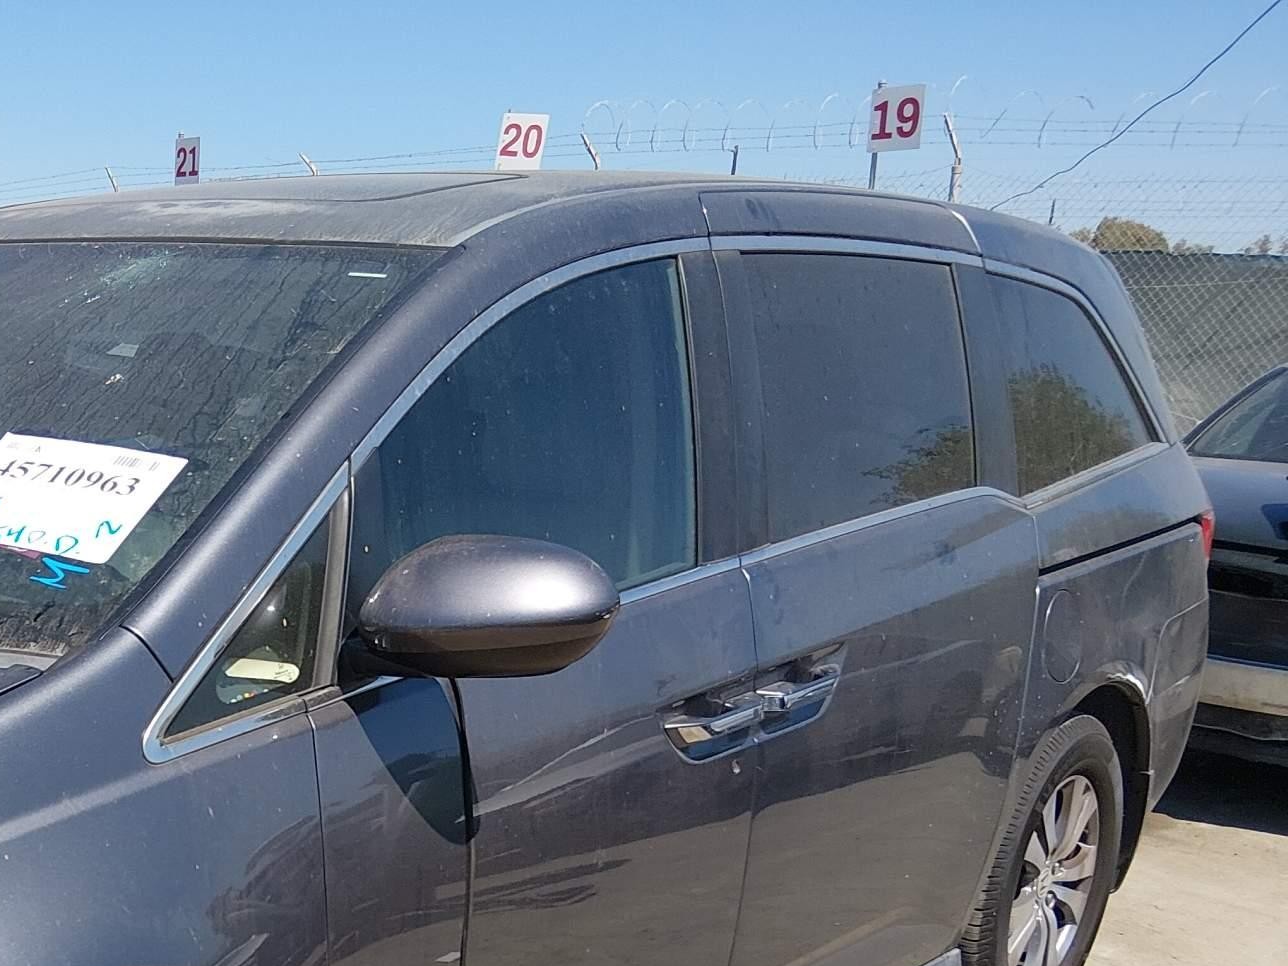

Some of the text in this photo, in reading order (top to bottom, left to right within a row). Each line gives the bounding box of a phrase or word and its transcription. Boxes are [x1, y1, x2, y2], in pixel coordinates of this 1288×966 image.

[871, 97, 920, 142] 19
[499, 123, 543, 158] 20
[176, 146, 199, 178] 21
